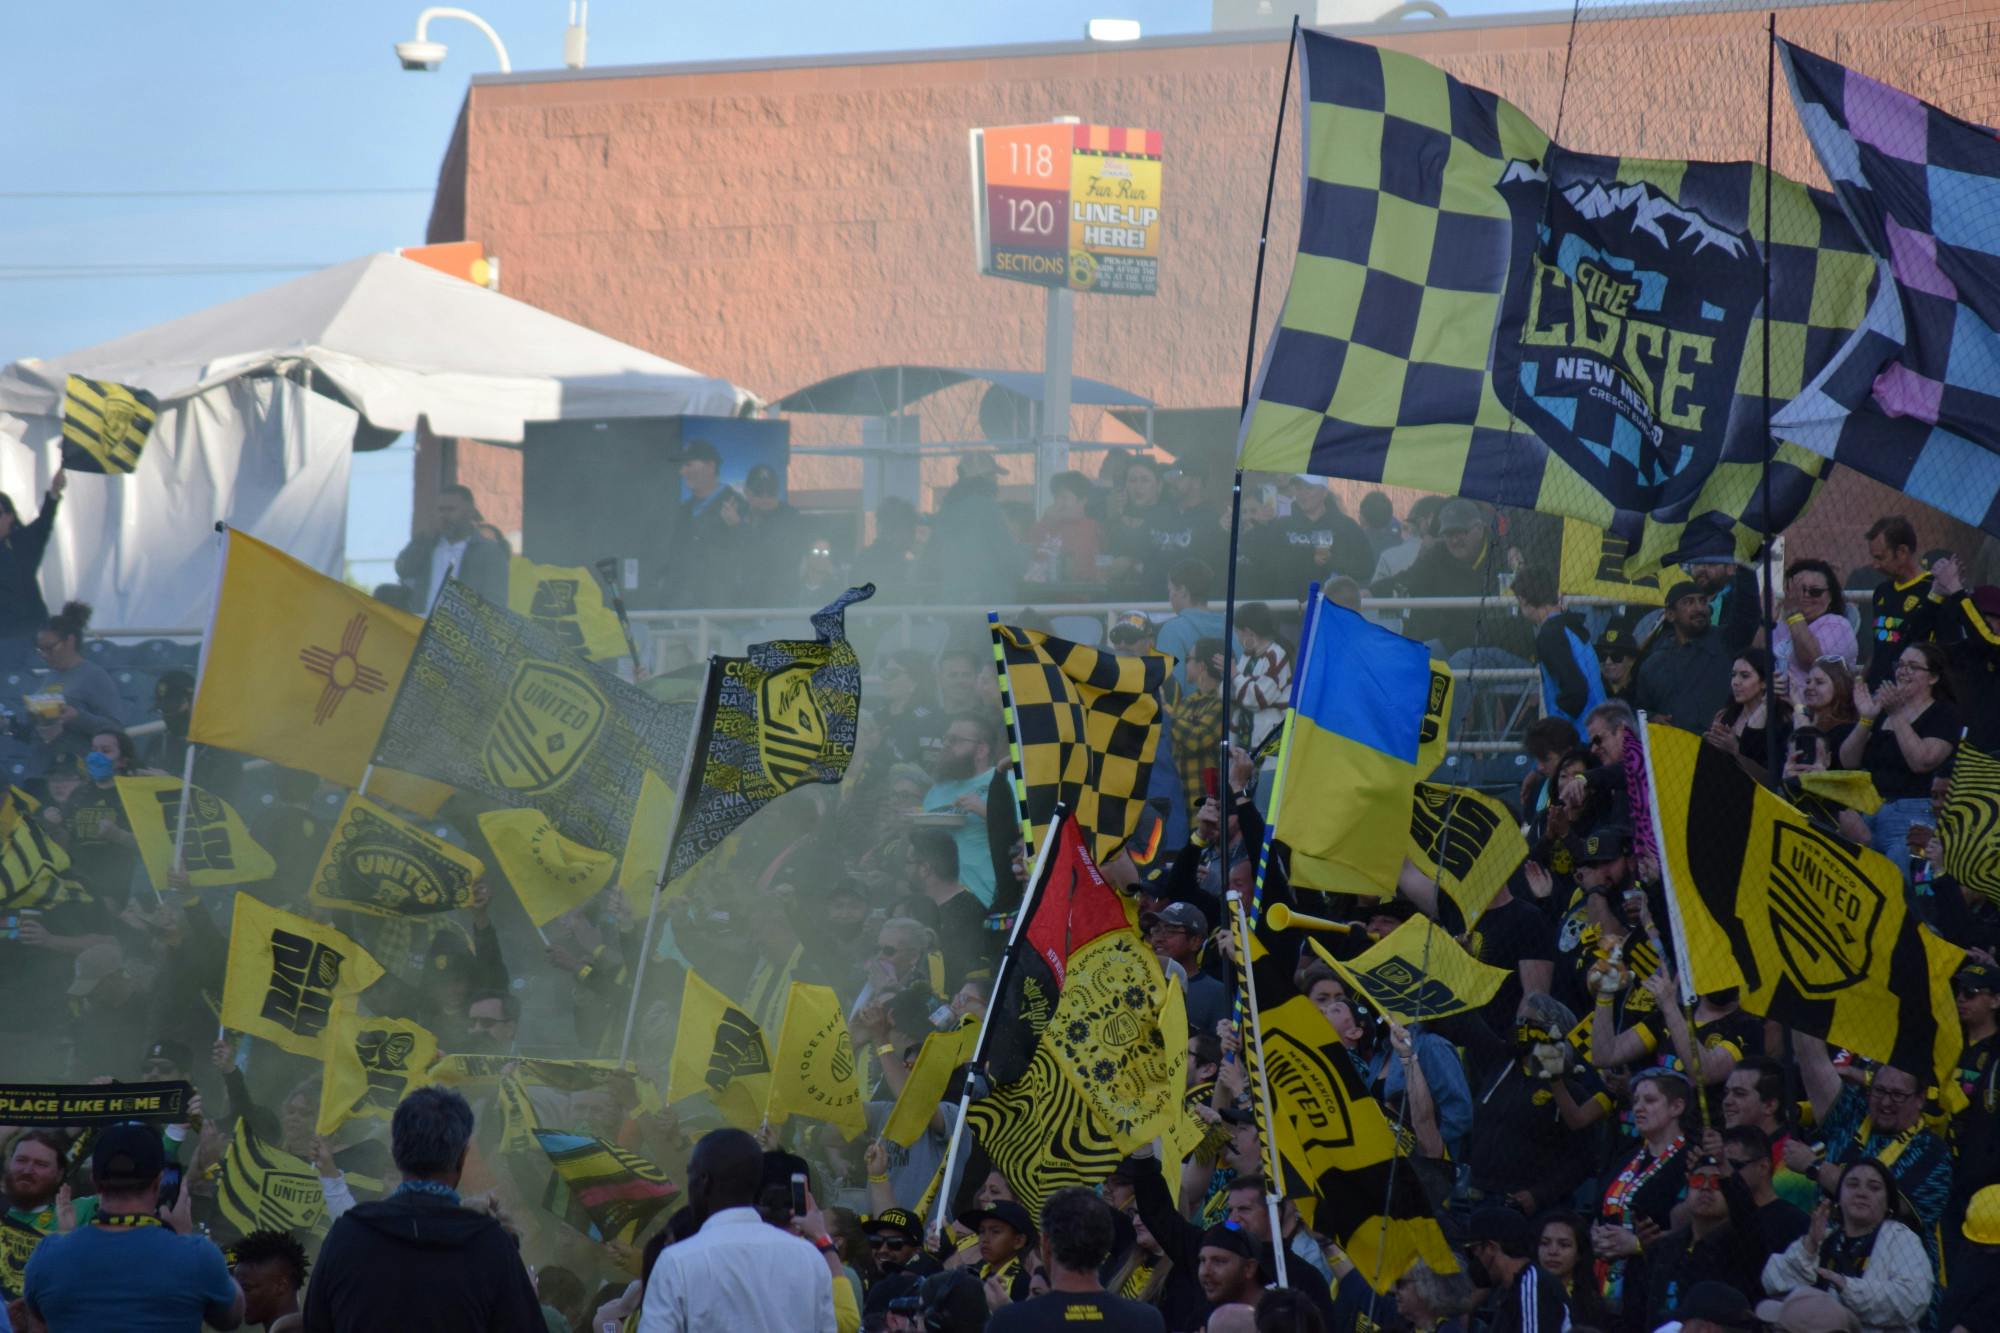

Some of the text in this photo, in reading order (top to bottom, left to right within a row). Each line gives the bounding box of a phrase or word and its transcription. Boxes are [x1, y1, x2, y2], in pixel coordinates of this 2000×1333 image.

[1009, 142, 1053, 177] 118
[1086, 175, 1147, 200] Fun Run
[1008, 198, 1054, 235] 120
[1073, 200, 1159, 227] LINE-UP
[1084, 224, 1146, 249] HERE!
[996, 251, 1064, 275] SECTIONS
[1576, 262, 1638, 317] THE
[1555, 356, 1616, 389] NEW
[1588, 385, 1632, 416] CRESCIT
[522, 682, 590, 731] UNITED
[1791, 844, 1861, 923] UNITED
[1819, 855, 1858, 890] MEXICO
[1288, 1050, 1337, 1115] NEW MEXICO
[0, 1098, 59, 1112] PLACE
[63, 1099, 105, 1112] LIKE
[273, 1184, 322, 1204] UNITED
